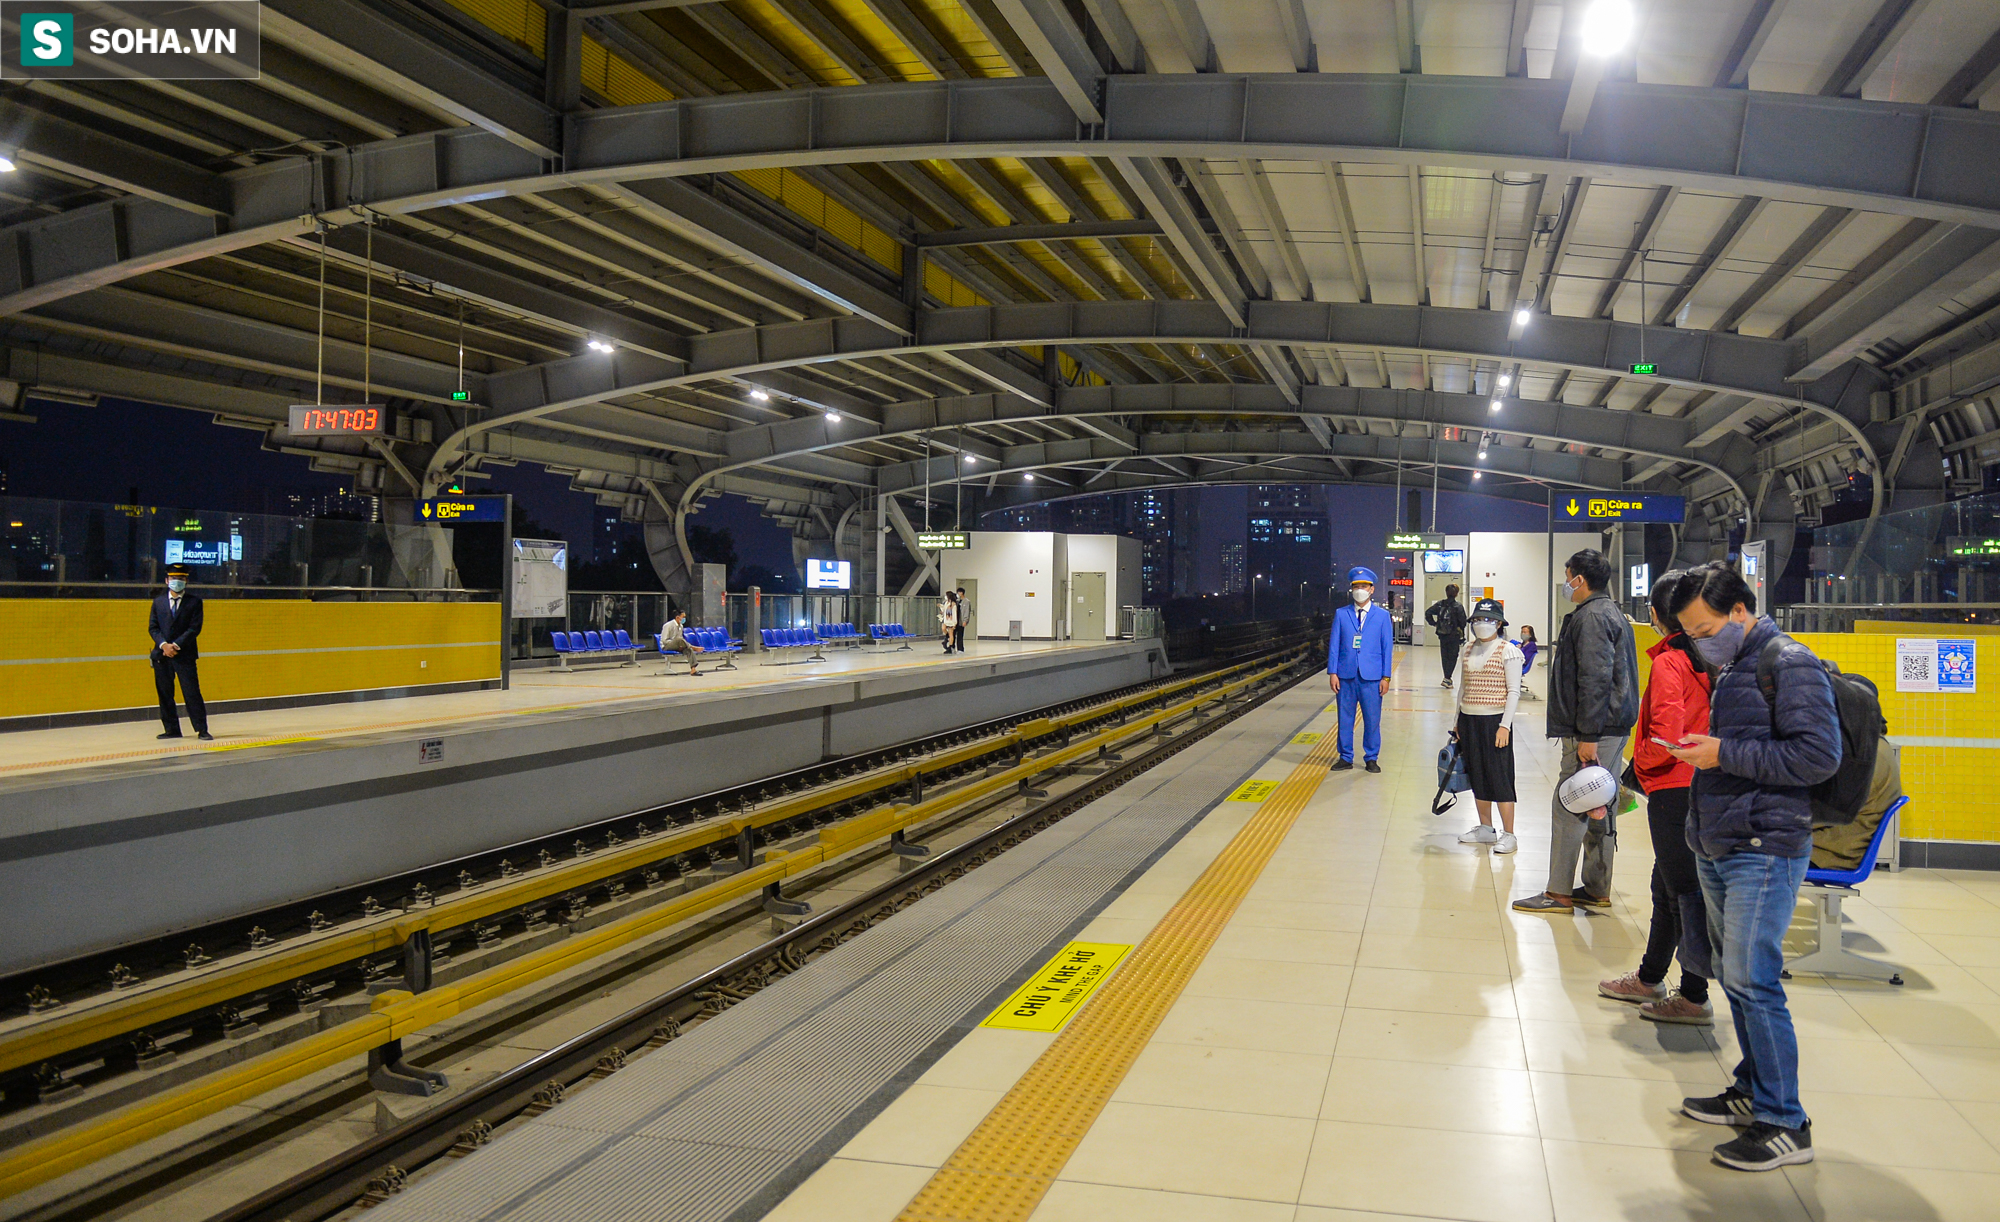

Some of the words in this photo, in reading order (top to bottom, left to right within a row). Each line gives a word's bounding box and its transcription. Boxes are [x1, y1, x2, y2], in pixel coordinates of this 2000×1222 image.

[304, 409, 378, 431] 17:47:03
[450, 502, 466, 511] Cửa
[466, 503, 475, 511] ra
[1608, 500, 1630, 509] Cửa
[1013, 995, 1052, 1017] CHÚ
[1047, 965, 1082, 984] KHE
[1068, 950, 1096, 963] HỞ
[1059, 987, 1083, 1004] MIND
[1076, 976, 1095, 987] THE
[1086, 964, 1104, 976] GAP
